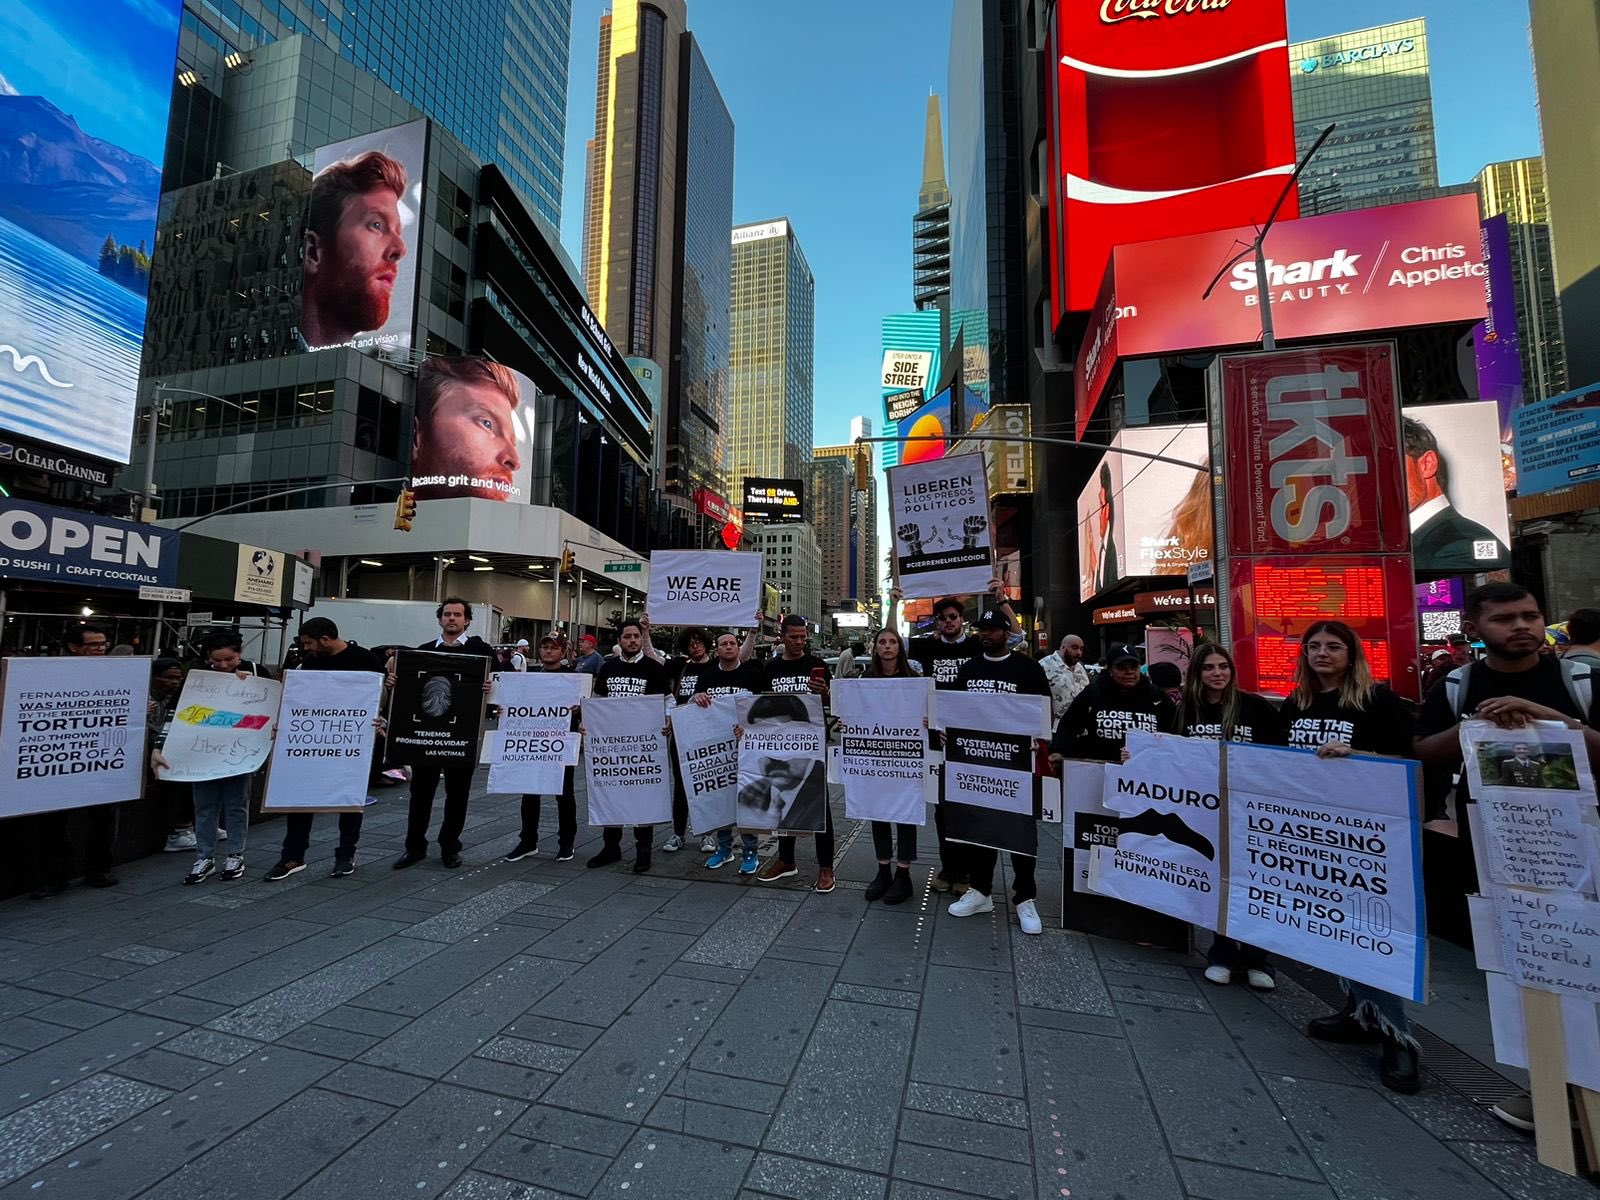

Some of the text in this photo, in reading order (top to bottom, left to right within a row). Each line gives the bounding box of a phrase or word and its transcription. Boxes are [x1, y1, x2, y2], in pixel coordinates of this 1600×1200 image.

[1322, 39, 1414, 68] BARCLAYS
[734, 230, 764, 240] Allianz
[1401, 243, 1466, 264] Chris
[1229, 249, 1361, 291] Shark
[1245, 283, 1352, 307] BEAUTY
[357, 334, 398, 348] and vision
[893, 362, 918, 373] SIDE
[884, 374, 924, 386] STREET
[893, 399, 918, 410] NEIGH-
[1266, 365, 1368, 542] tkts
[1251, 385, 1266, 542] service Theatre Development Fund
[412, 474, 520, 496] Because grit and vision
[904, 475, 972, 496] LIBEREN
[747, 495, 766, 503] There
[914, 488, 974, 503] LOS PRESOS
[905, 497, 975, 514] POLÍTICOS
[0, 509, 162, 568] OPEN
[1141, 547, 1208, 560] FlexStyle
[12, 558, 158, 584] SUSHI CRAFT COCKTAILS
[666, 576, 741, 592] WE ARE
[666, 590, 741, 604] DIASPORA
[1154, 595, 1182, 606] We're
[772, 676, 796, 685] CLOSE
[967, 679, 1017, 691] CLOSE THE
[20, 688, 130, 699] FERNANDO ALBÁN
[607, 684, 646, 693] TORTURE
[20, 699, 129, 710] WAS MURDERED
[61, 709, 101, 717] REGIME
[291, 709, 367, 717] WE MIGRATED
[507, 707, 569, 717] ROLAND
[1096, 710, 1157, 723] CLOSE THE
[18, 715, 128, 733] TORTURE
[290, 719, 365, 732] SO THEY
[843, 723, 919, 736] John Álvarez
[1096, 719, 1157, 733] TORTURE
[1324, 719, 1354, 733] THE
[19, 728, 127, 748] AND THROWN 10
[288, 734, 364, 744] WOULDN'T
[396, 737, 433, 745] PROHIBIDO
[602, 734, 656, 743] VENEZUELA
[786, 733, 819, 741] CIERRA
[19, 740, 98, 754] FROM THE
[504, 739, 564, 752] PRESO
[591, 745, 618, 753] THERE
[641, 743, 658, 752] 300
[757, 742, 819, 750] HELICOIDE
[846, 739, 921, 750] ESTÁ RECIBIENDO
[956, 737, 1019, 753] SYSTEMATIC
[19, 747, 125, 765] FLOOR OF A
[286, 749, 360, 757] TORTURE US
[846, 748, 880, 756] DESCARGAS
[963, 747, 1012, 761] TORTURE
[593, 754, 655, 765] POLITICAL
[689, 755, 722, 772] PARA
[872, 759, 923, 768] TESTÍCULOS
[17, 758, 124, 779] BUILDING
[593, 765, 662, 776] PRISONERS
[877, 770, 923, 779] COSTILLAS
[619, 778, 661, 786] TORTURED
[694, 772, 737, 796] PRES
[956, 773, 1019, 789] SYSTEMATIC
[959, 782, 1017, 798] DENOUNCE
[1118, 778, 1221, 810] MADURO
[1247, 801, 1385, 832] A FERNANDO ALBÁN
[1094, 824, 1119, 835] TOR
[1248, 815, 1385, 854] LO ASESINÓ
[1248, 835, 1386, 874] EL RÉGIMEN CON
[1115, 849, 1209, 880] ASESINO DE LESA
[1247, 848, 1387, 895] TORTURAS
[1114, 858, 1211, 893] HUMANIDAD
[1249, 870, 1392, 938] Y LO LANZÓ 10
[1249, 886, 1345, 923] DEL PISO
[1511, 894, 1558, 917] Help
[1248, 903, 1393, 956] DE UN EDIFICIO
